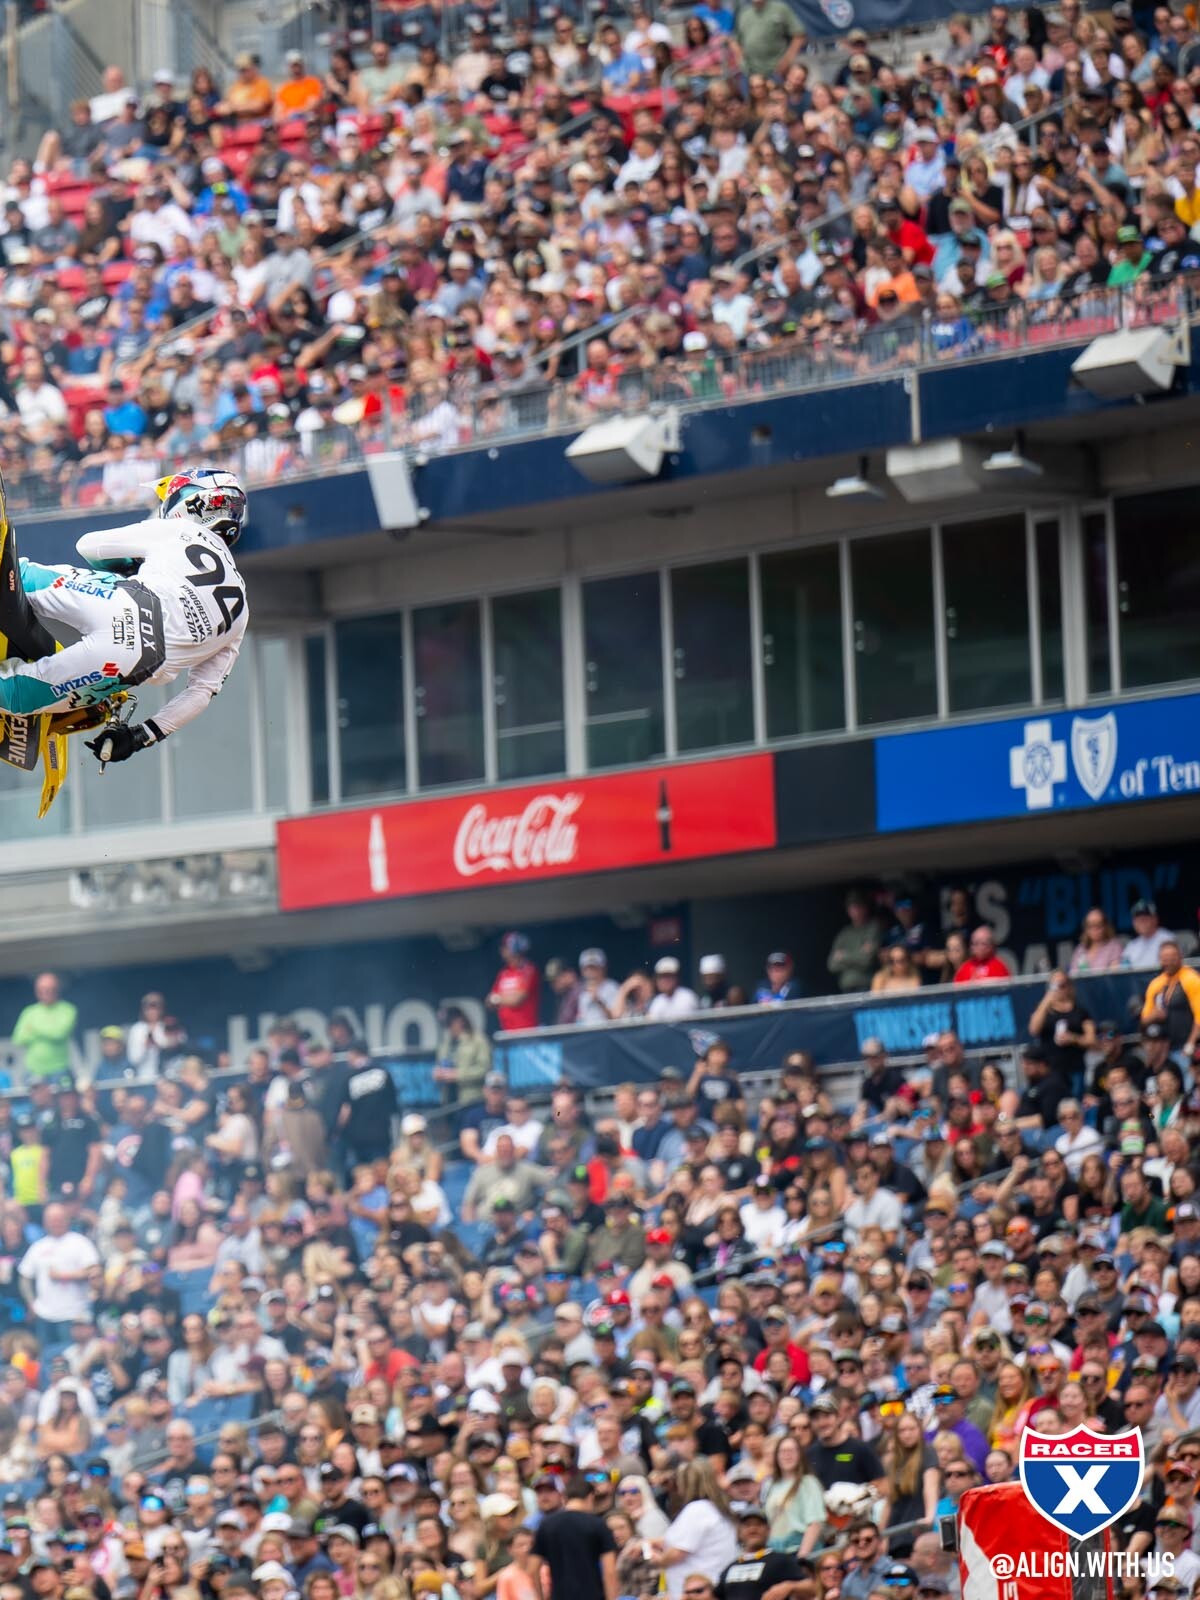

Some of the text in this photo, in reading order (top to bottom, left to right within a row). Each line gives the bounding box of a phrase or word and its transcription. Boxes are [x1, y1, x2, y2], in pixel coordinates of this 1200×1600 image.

[64, 580, 115, 600] SUZUKI
[180, 584, 214, 637] PROGRESSIVE
[185, 544, 244, 637] 94
[140, 607, 156, 652] FOX
[51, 670, 104, 698] SUZUKI
[1119, 758, 1148, 798] of
[453, 792, 584, 876] Coca-Cola
